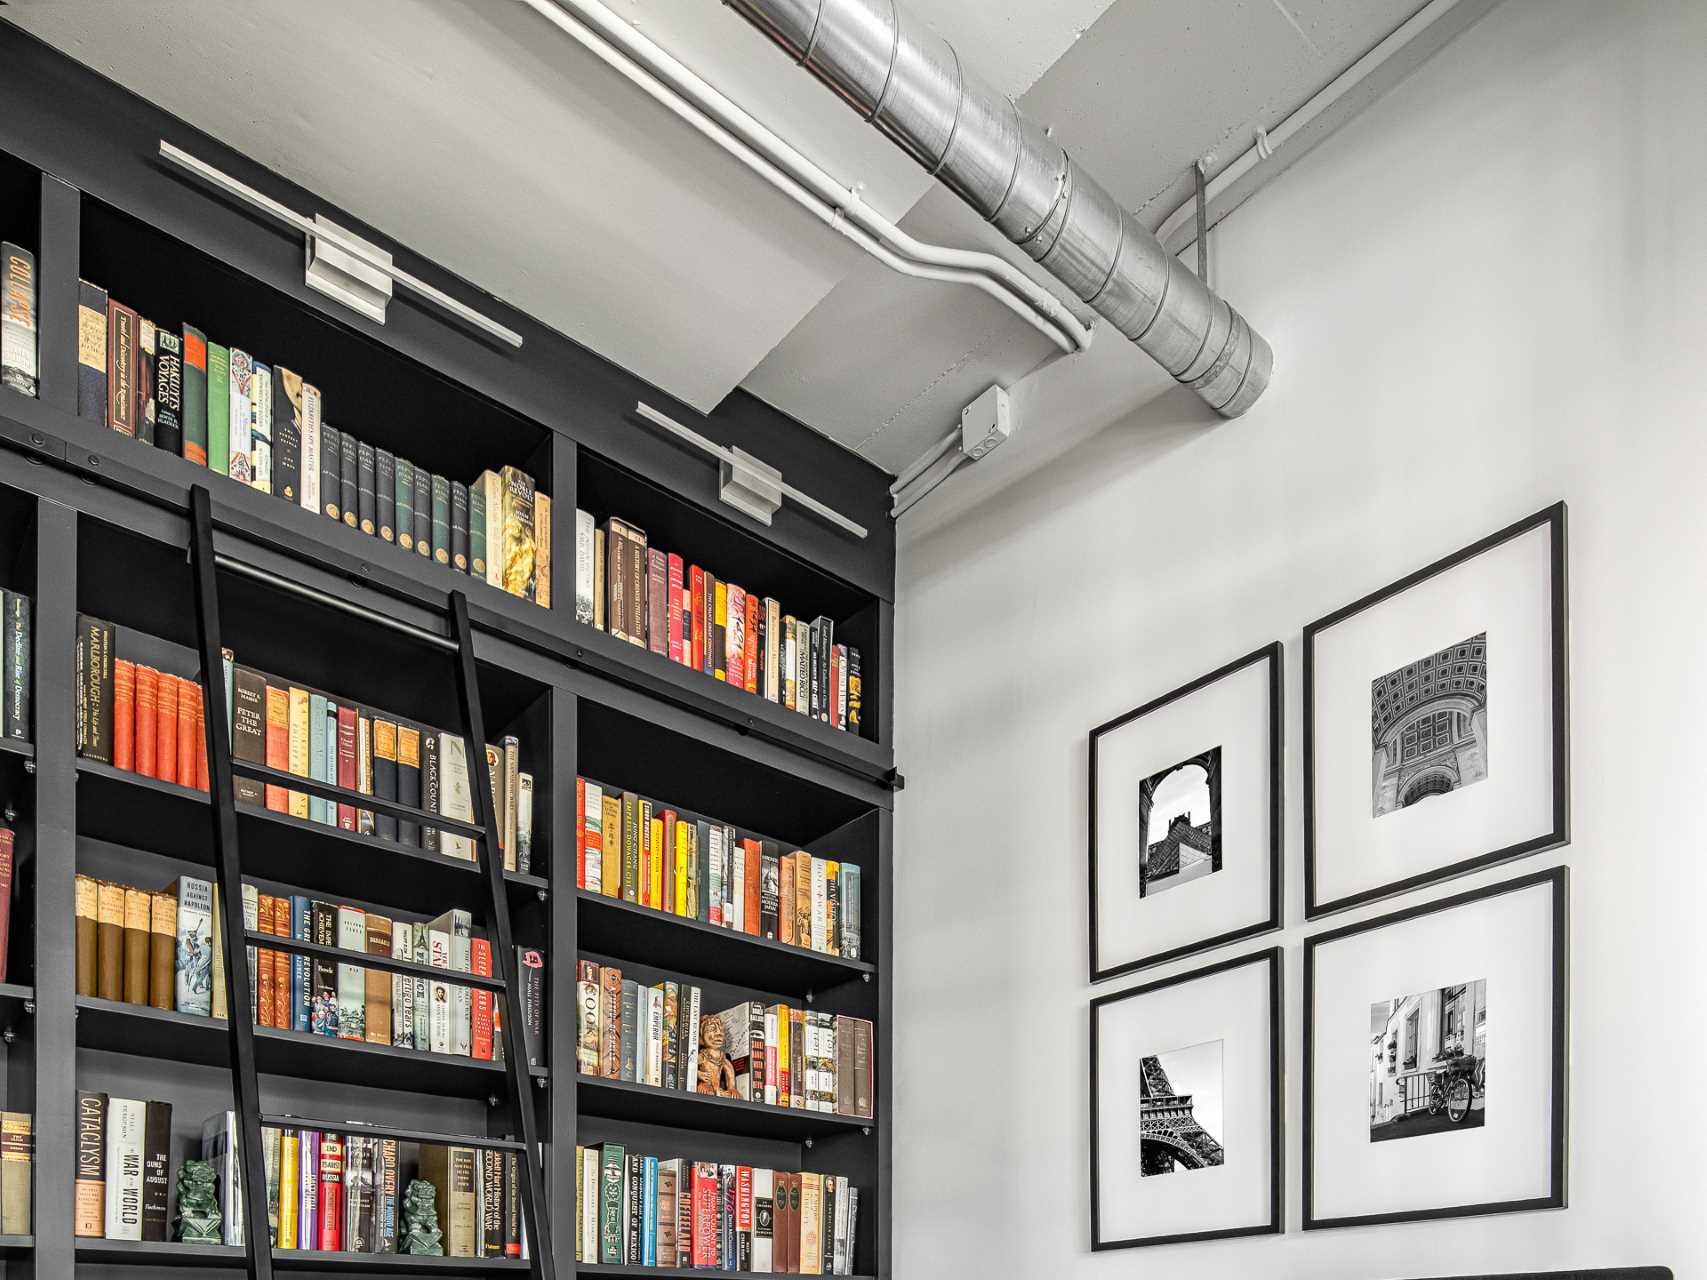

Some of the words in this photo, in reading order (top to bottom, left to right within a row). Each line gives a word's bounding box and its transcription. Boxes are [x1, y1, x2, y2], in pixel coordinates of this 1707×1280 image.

[158, 355, 170, 405] VOYAGES
[15, 630, 23, 656] Decline
[13, 685, 23, 721] Democracy
[238, 706, 261, 721] PETER
[236, 723, 263, 737] GREAT
[242, 716, 258, 727] THE
[429, 754, 437, 781] BLACK
[429, 781, 437, 815] COUNT
[186, 881, 209, 892] RUSSIA
[186, 890, 208, 901] AGAINST
[183, 900, 211, 911] NAPOLEON
[303, 910, 311, 926] THE
[303, 955, 311, 1007] REVOLUTION
[81, 1097, 102, 1176] CATACLYSM
[123, 1153, 139, 1176] WAR
[157, 1153, 167, 1163] THE
[631, 1156, 639, 1173] AND
[146, 1175, 167, 1187] AUGUST
[383, 1170, 397, 1194] OVERY
[122, 1187, 139, 1226] WORLD
[484, 1181, 493, 1211] WORLD
[490, 1187, 502, 1209] History
[725, 1189, 736, 1215] 1776
[740, 1170, 750, 1224] WASHINGTON
[484, 1213, 493, 1231] WAR
[493, 1220, 502, 1230] the
[631, 1217, 638, 1227] OF
[702, 1187, 711, 1258] SUPERPOWER
[710, 1213, 718, 1242] COLONY
[631, 1230, 639, 1260] MEXICO
